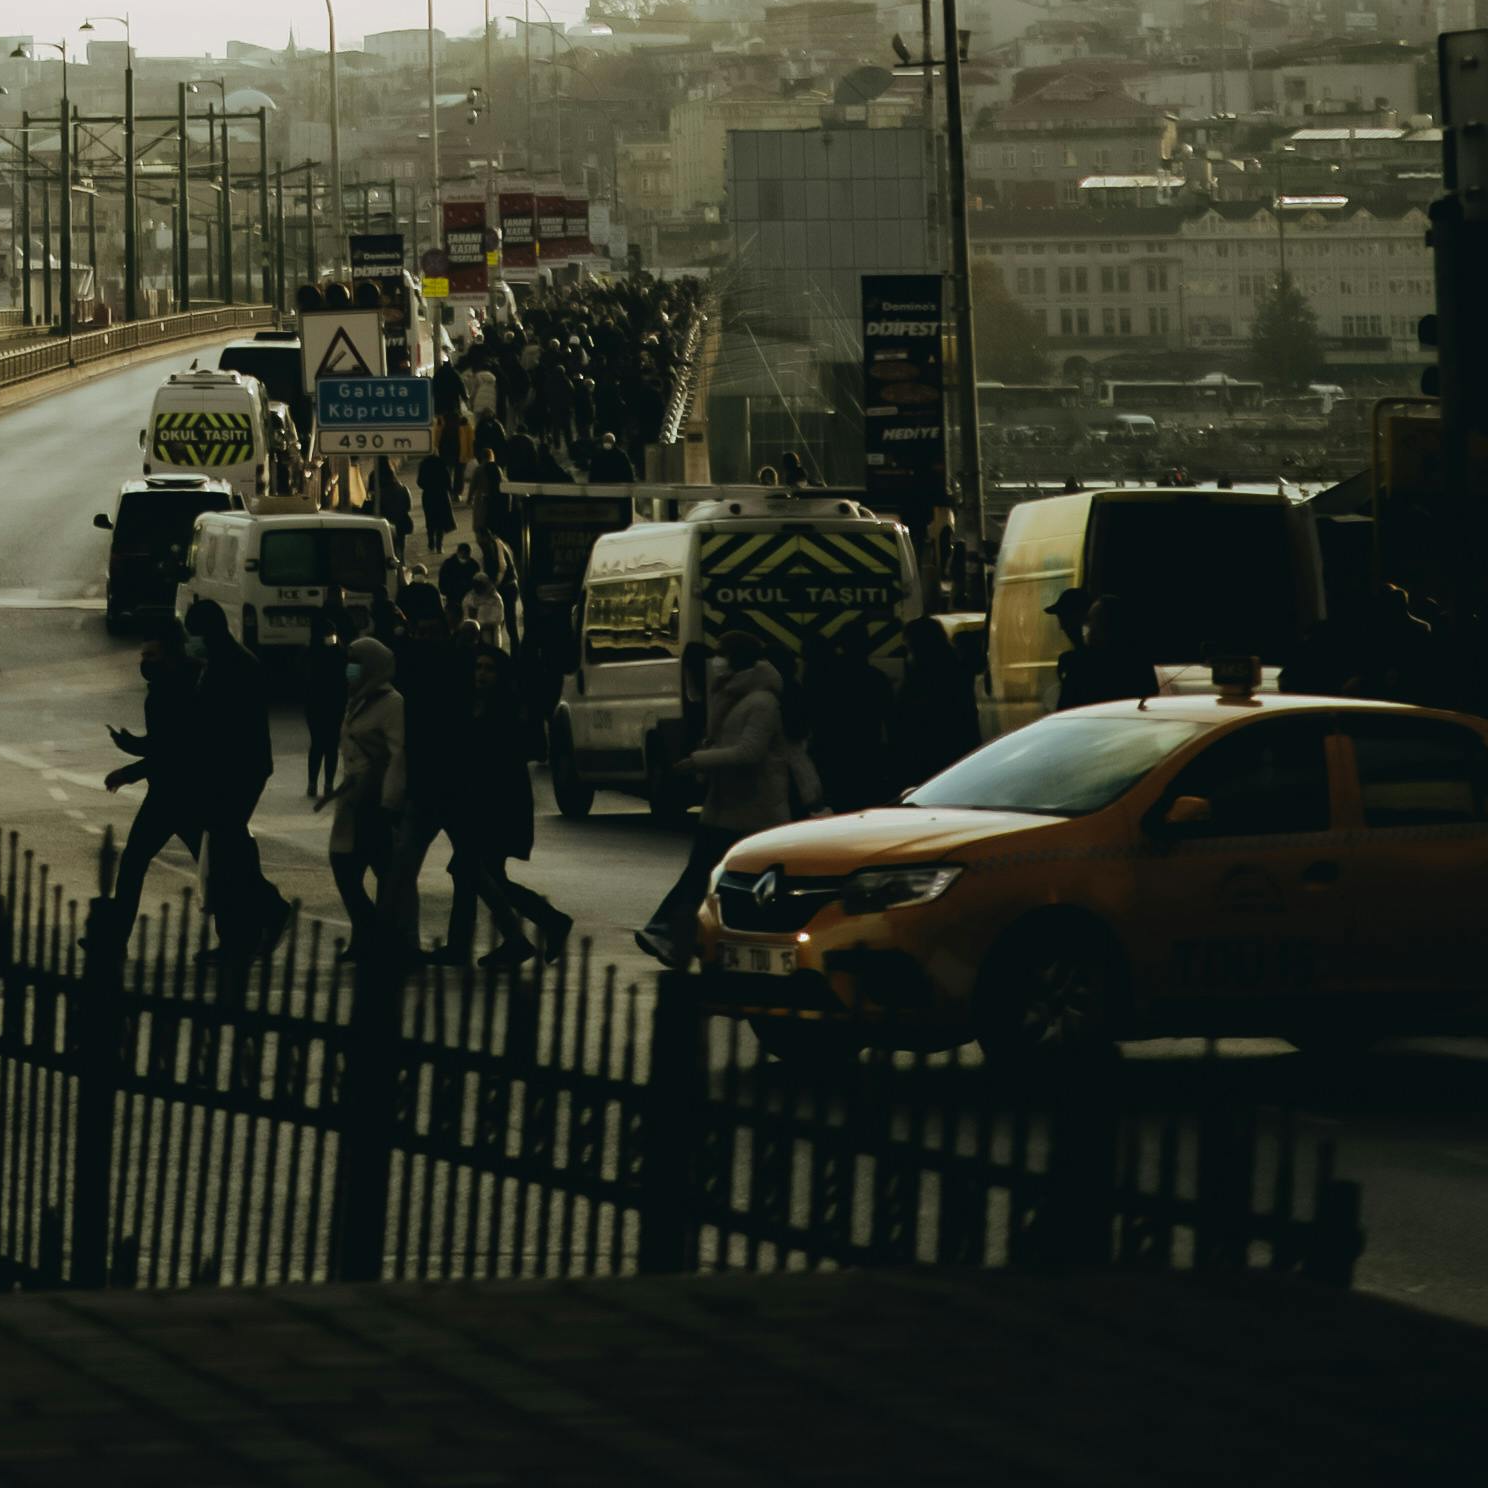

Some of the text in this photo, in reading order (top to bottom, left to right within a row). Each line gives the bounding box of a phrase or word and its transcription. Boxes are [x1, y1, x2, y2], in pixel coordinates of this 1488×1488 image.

[881, 301, 937, 312] Domino's
[339, 384, 409, 399] Galata
[328, 403, 420, 420] Köprüsü
[160, 430, 198, 441] OKUL
[339, 434, 412, 449] 490 m
[716, 587, 888, 605] OKUL TAŞITI
